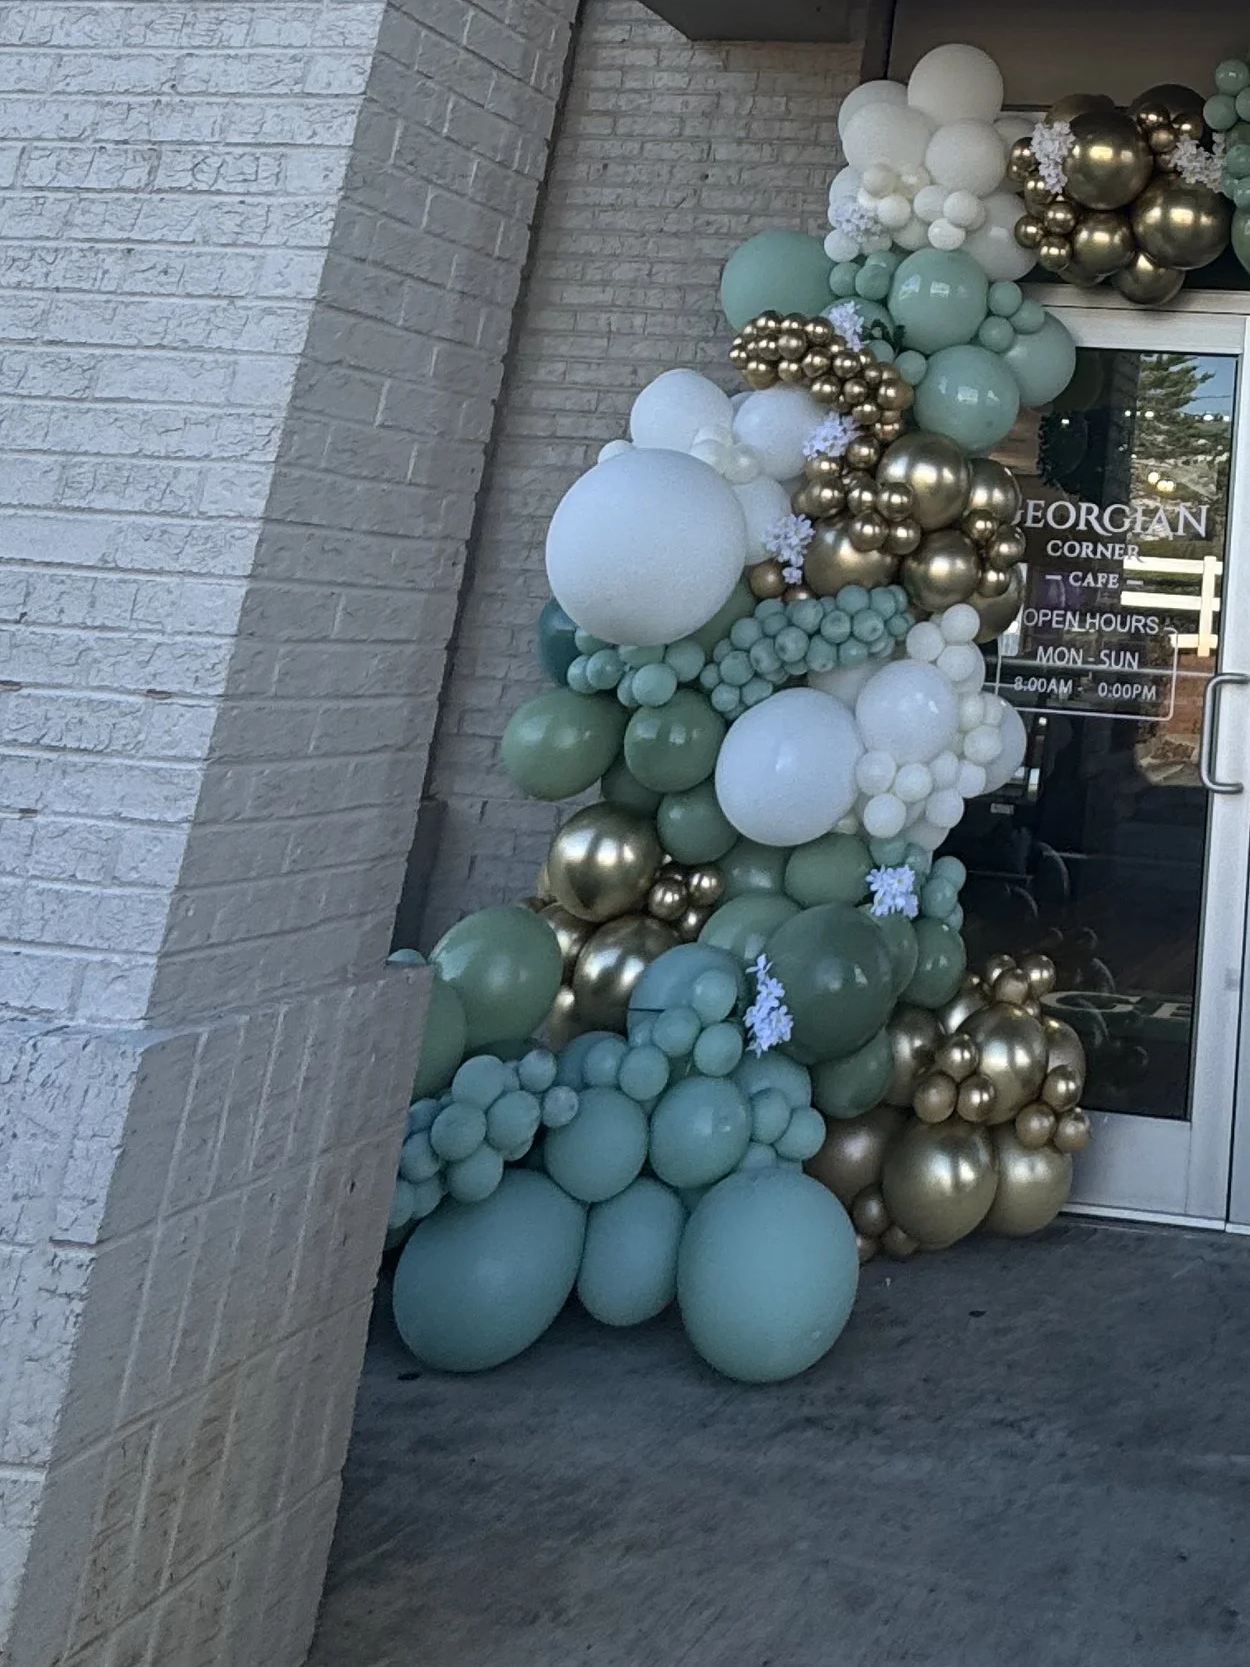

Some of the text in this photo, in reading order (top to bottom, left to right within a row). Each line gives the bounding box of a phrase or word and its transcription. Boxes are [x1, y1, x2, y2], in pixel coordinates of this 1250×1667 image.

[1012, 498, 1210, 538] EORGIAN
[1046, 539, 1144, 563] CORNER
[1068, 571, 1120, 589] CAFE
[1023, 608, 1160, 634] OPEN HOURS
[1036, 645, 1083, 665] MON
[1100, 649, 1139, 669] SUN
[1013, 676, 1073, 694] 8:00AM
